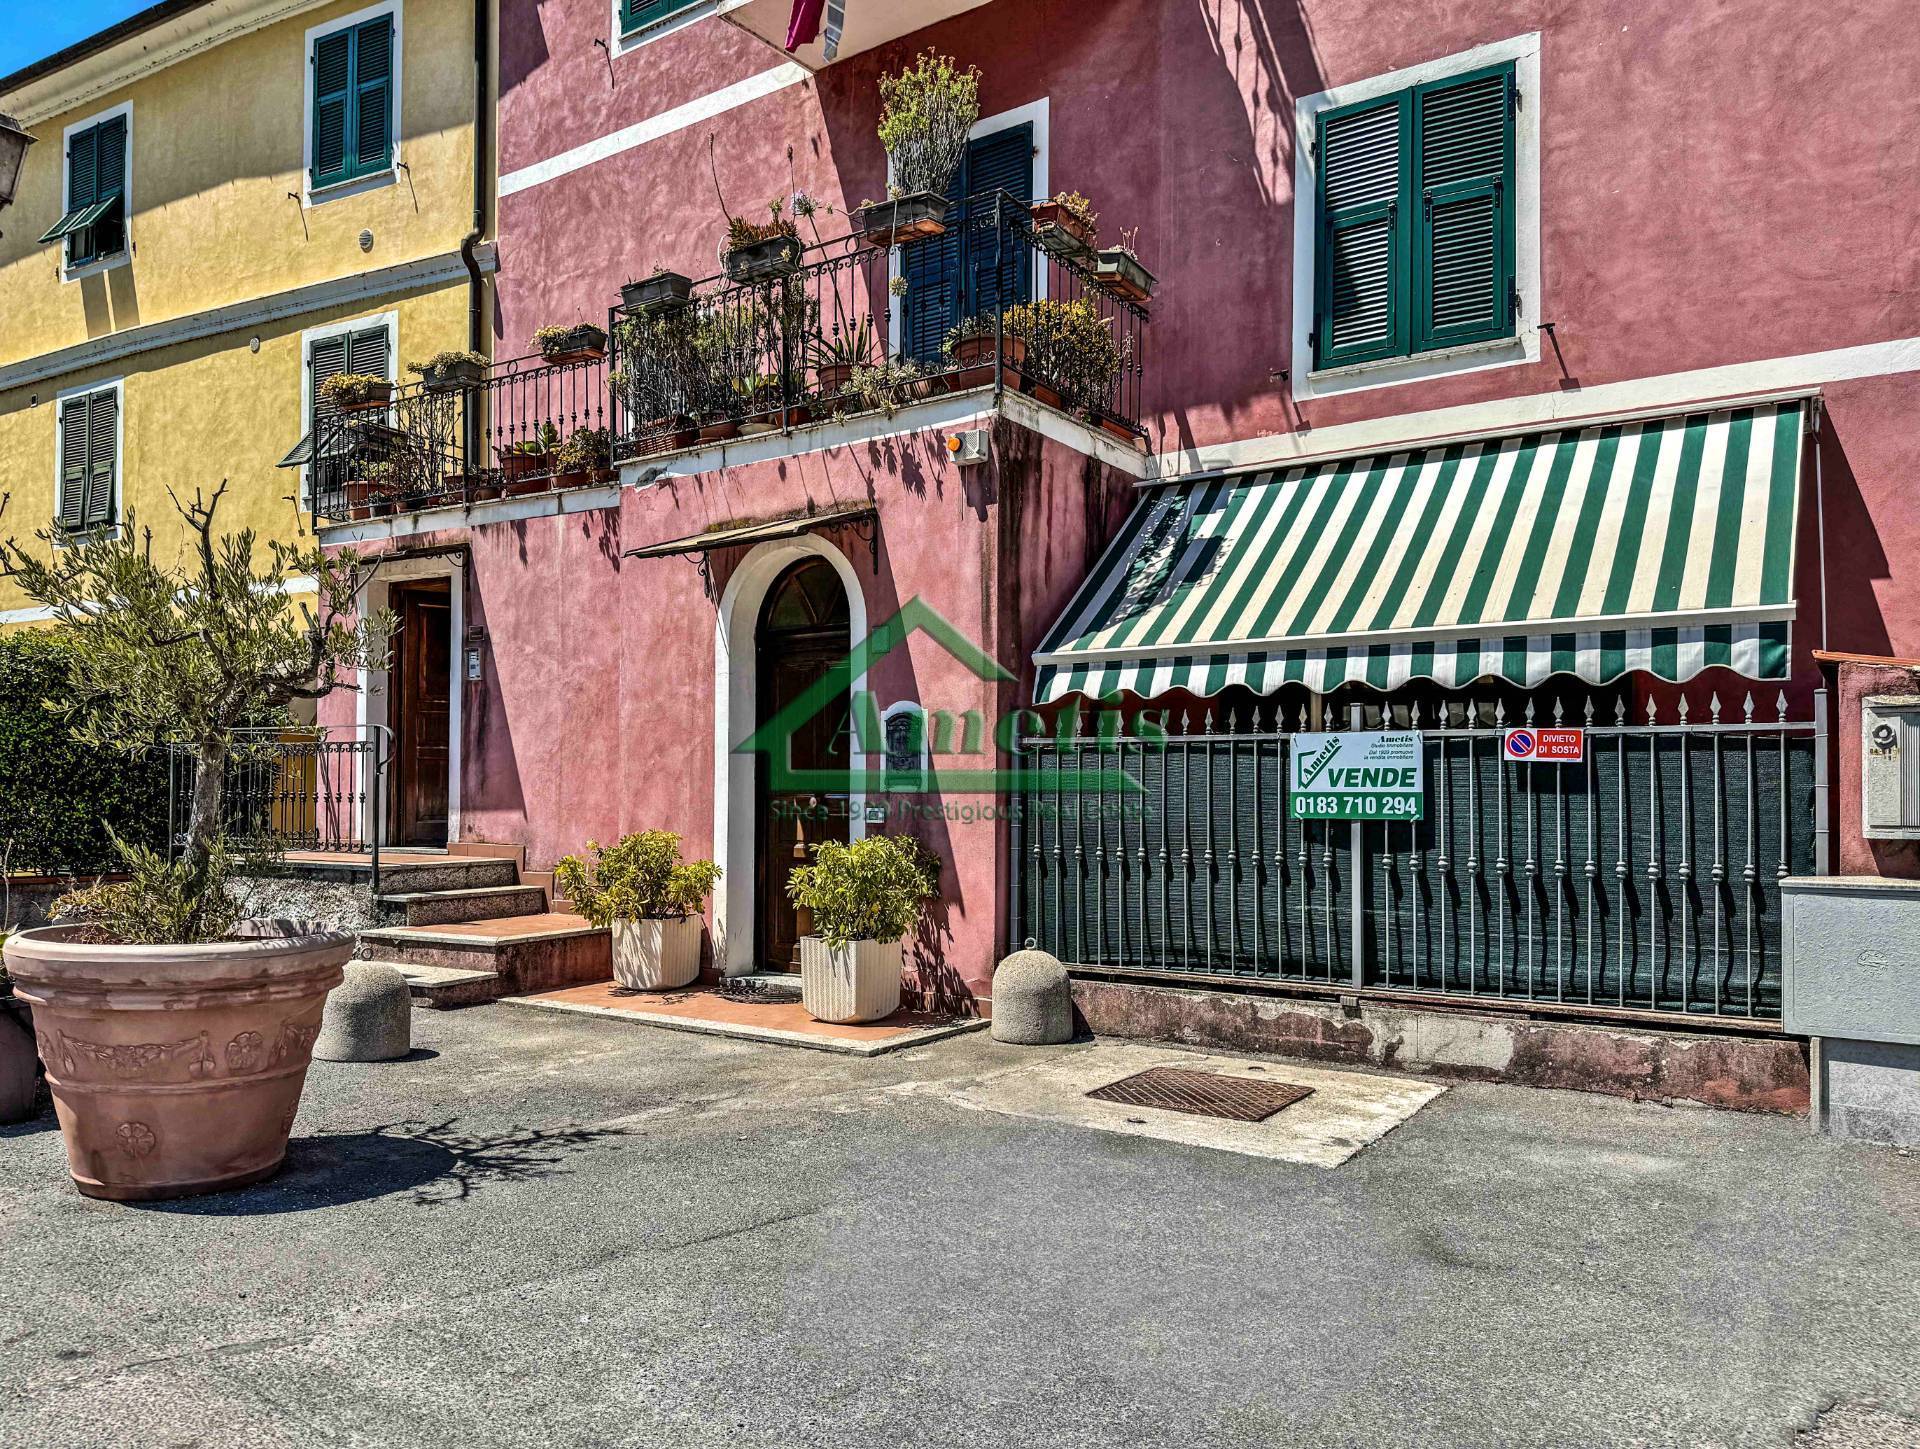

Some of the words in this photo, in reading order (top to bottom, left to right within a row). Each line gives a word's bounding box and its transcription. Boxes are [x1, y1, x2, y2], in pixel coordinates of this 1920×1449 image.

[1377, 735, 1414, 743] Ametis
[1542, 734, 1577, 743] DIVIETO
[1538, 745, 1548, 754] DI
[1551, 745, 1580, 754] SOSTA
[1303, 736, 1341, 780] Ametis
[1327, 767, 1418, 788] VENDE
[1295, 796, 1338, 815] 0183
[1343, 796, 1377, 815] 710
[1382, 796, 1417, 815] 294
